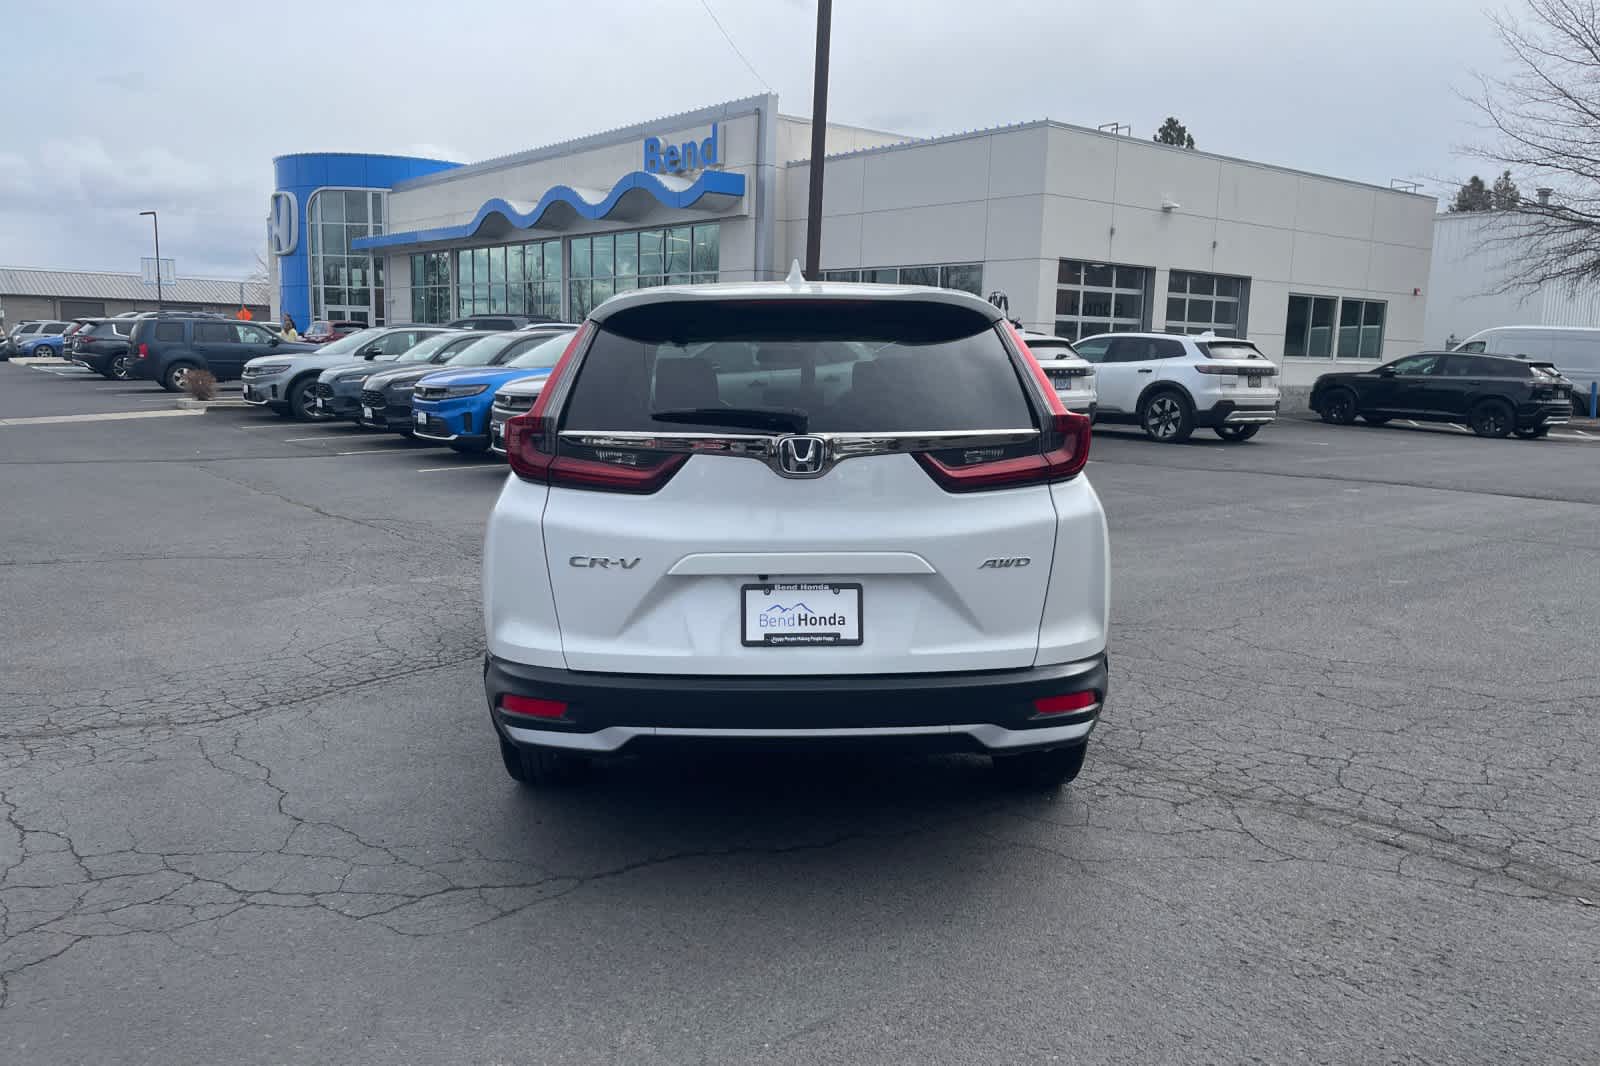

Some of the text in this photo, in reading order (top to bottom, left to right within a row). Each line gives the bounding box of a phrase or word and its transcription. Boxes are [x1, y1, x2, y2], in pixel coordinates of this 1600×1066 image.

[643, 122, 718, 173] Bend
[569, 556, 641, 569] CR-V
[978, 557, 1031, 569] AWD
[759, 613, 846, 628] Bend Honda
